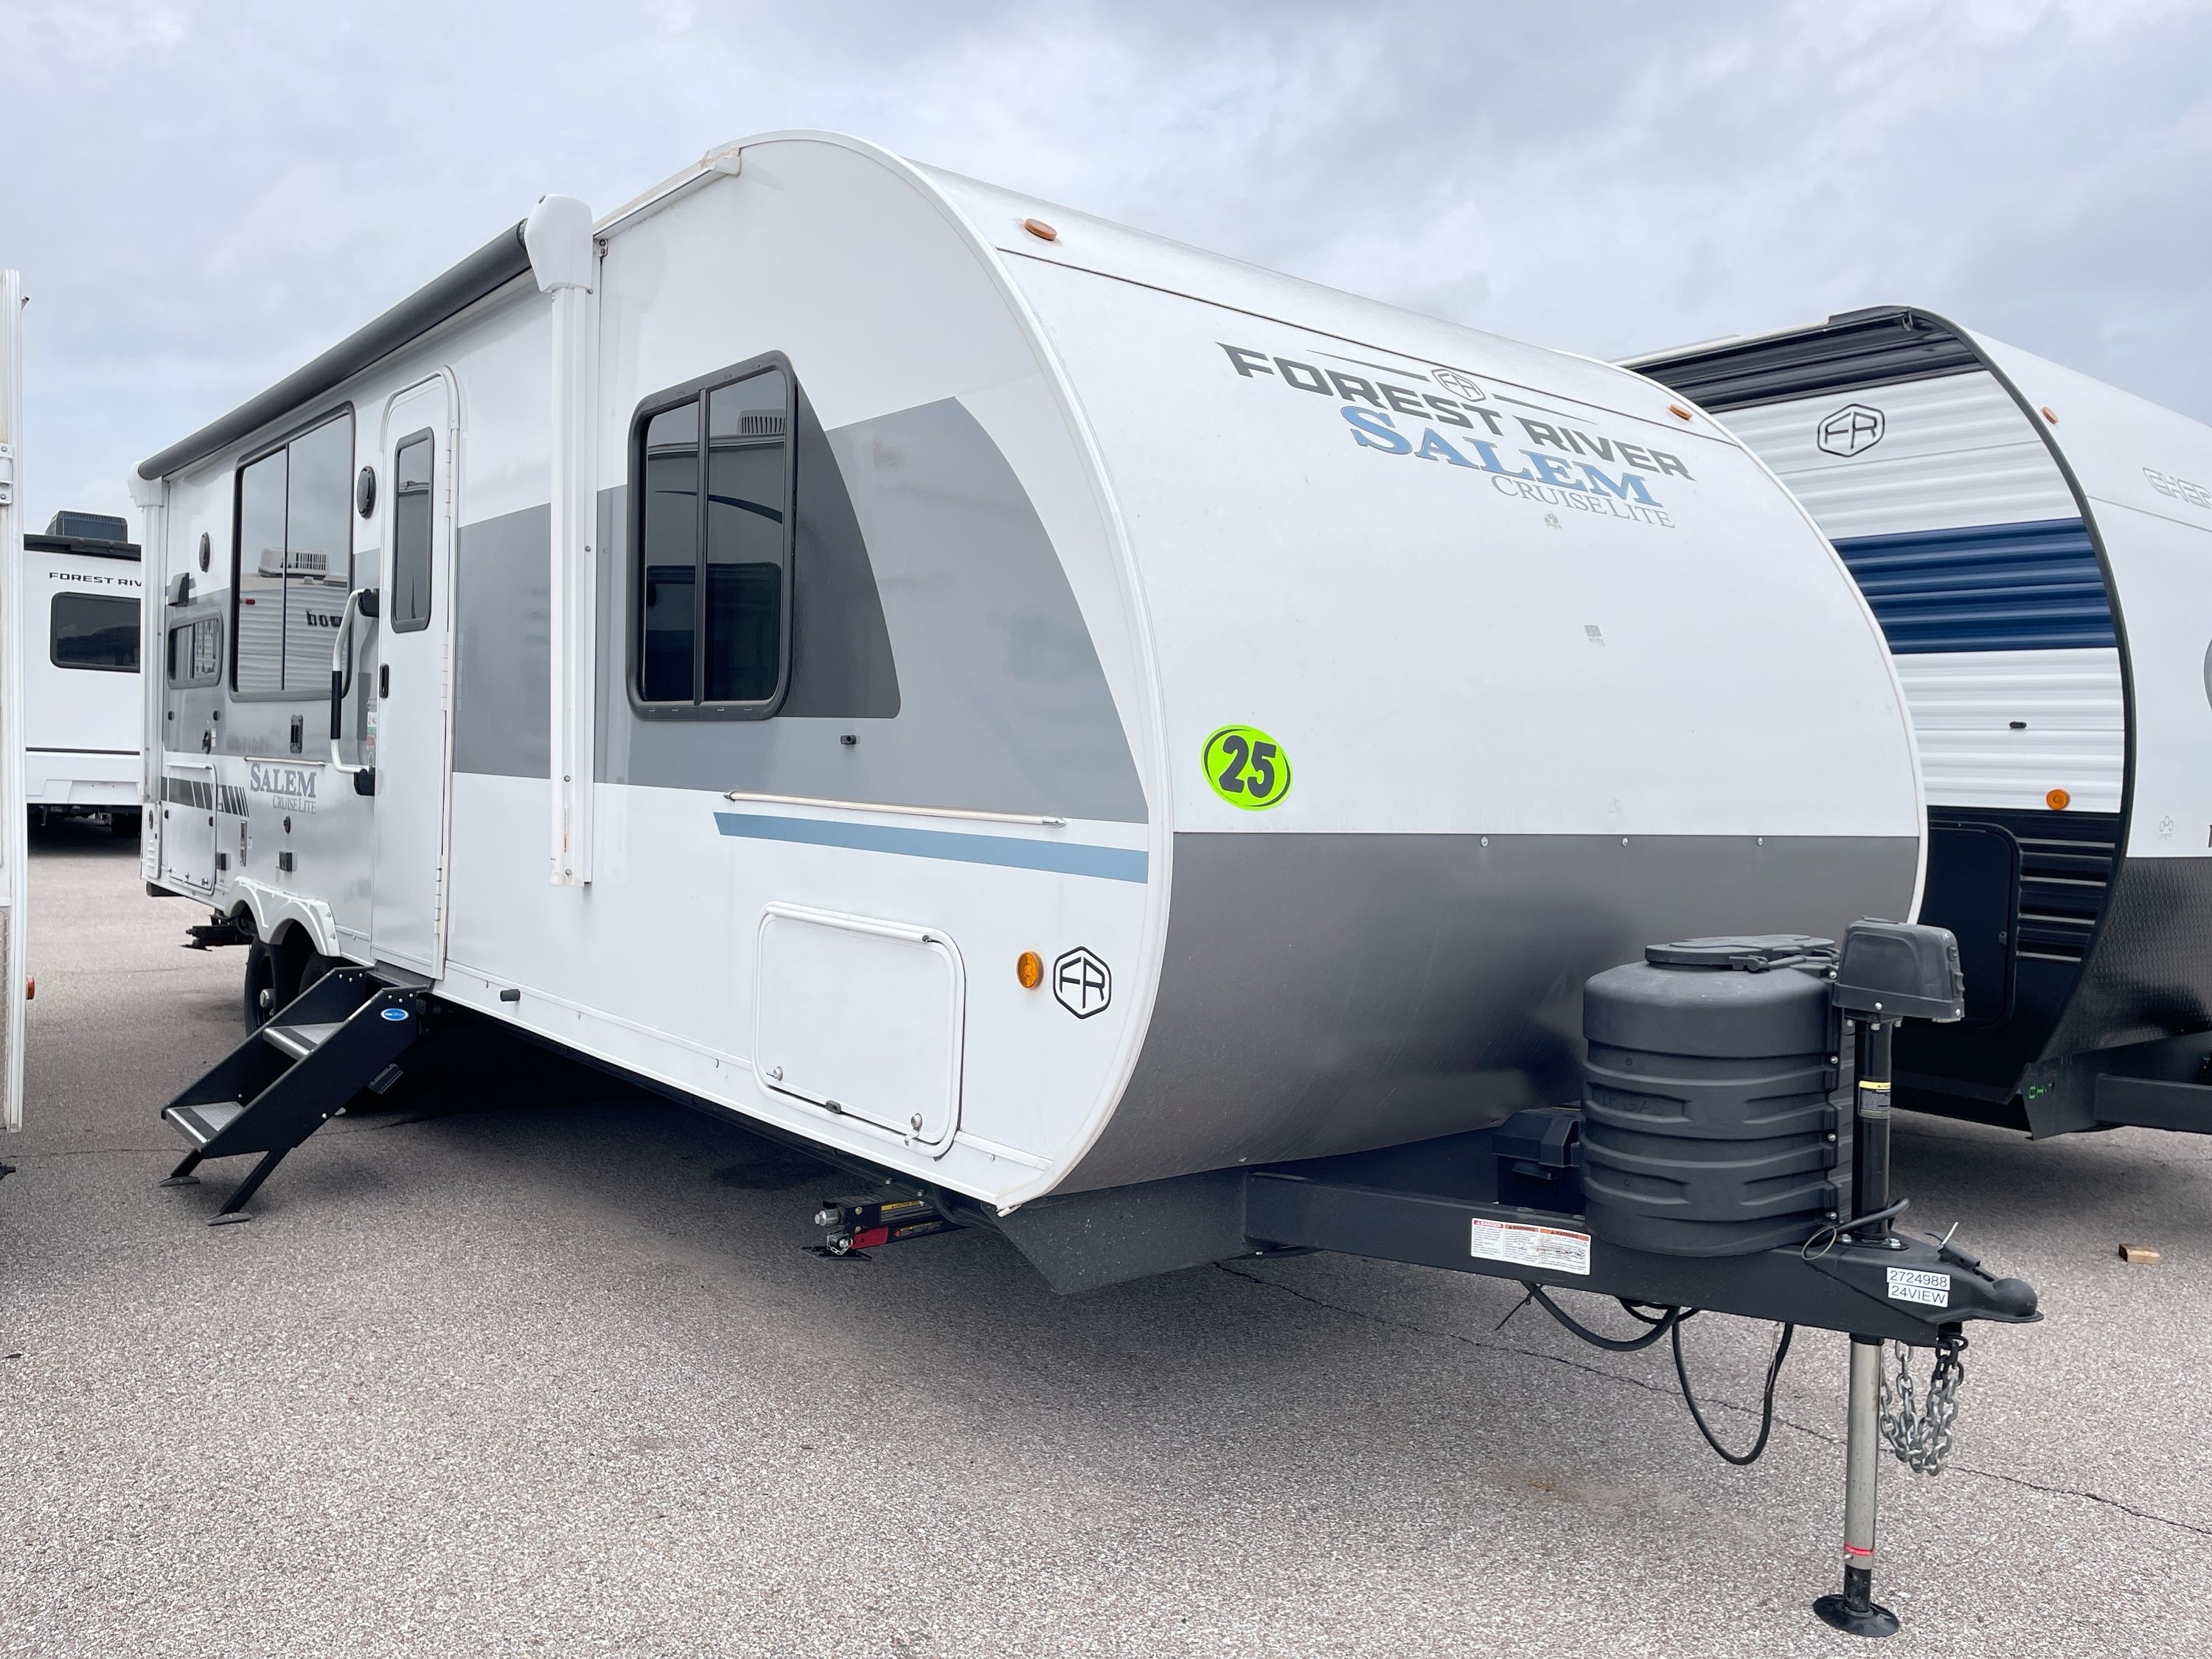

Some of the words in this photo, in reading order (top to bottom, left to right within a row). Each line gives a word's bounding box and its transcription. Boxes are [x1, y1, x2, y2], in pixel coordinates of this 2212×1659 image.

[1215, 341, 1502, 435] FOREST
[1514, 414, 1696, 481] RIVER
[1340, 406, 1663, 509] SALEM
[49, 571, 114, 584] FOREST
[251, 762, 317, 799] SALEM
[1218, 734, 1276, 799] 25
[1556, 1231, 1579, 1239] WARNING
[1890, 1270, 1947, 1287] 2724988
[1891, 1285, 1945, 1304] 24VIEW
